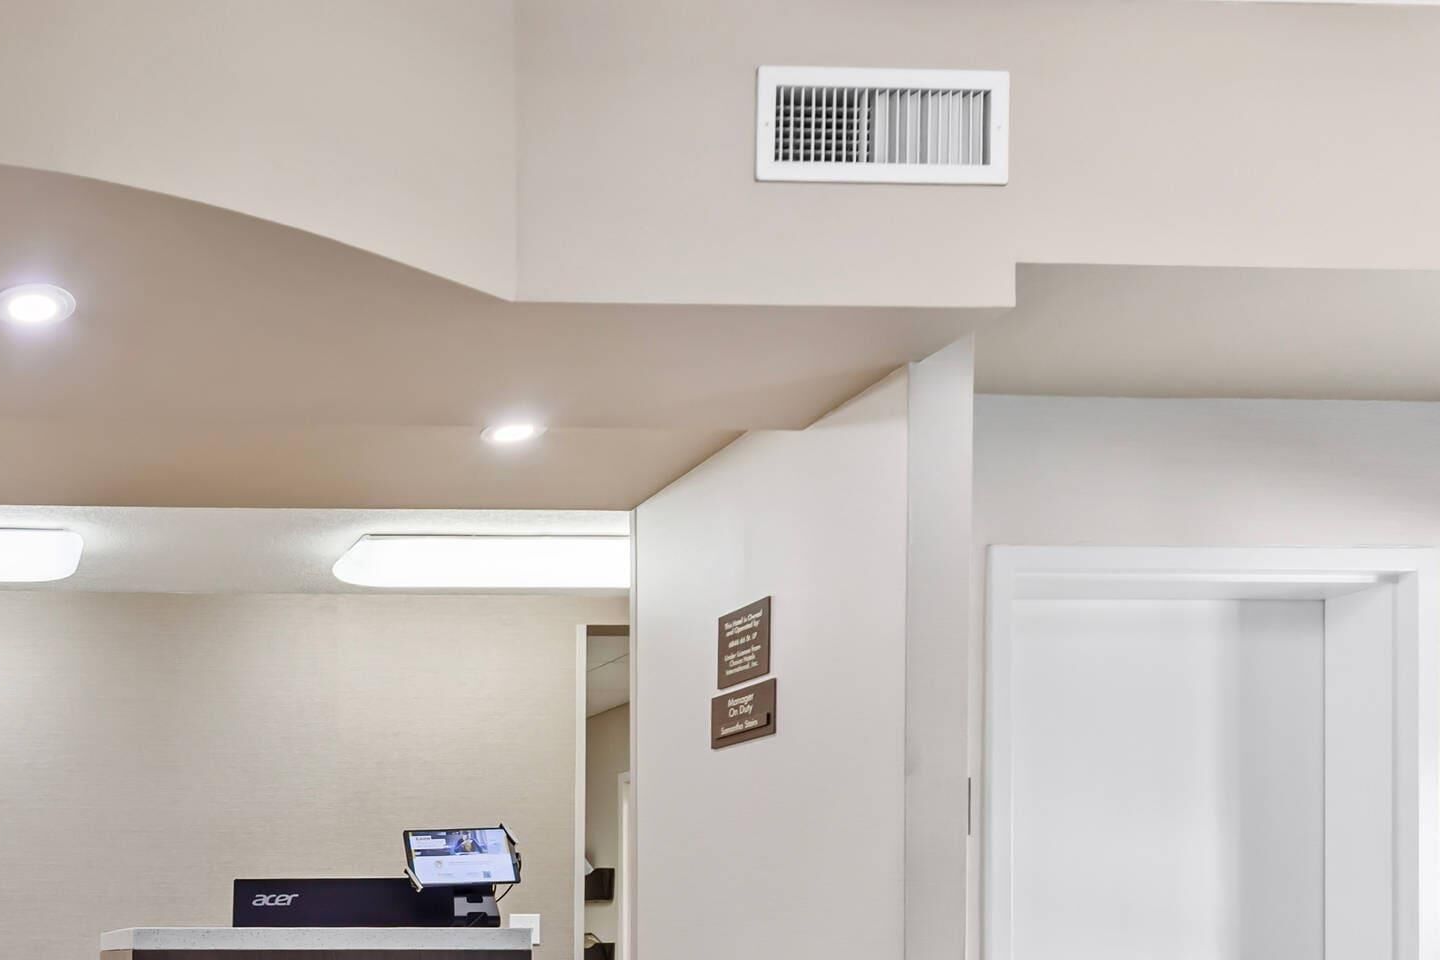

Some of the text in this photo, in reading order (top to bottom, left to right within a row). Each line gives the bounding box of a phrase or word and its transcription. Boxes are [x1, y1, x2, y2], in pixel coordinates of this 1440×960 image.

[727, 692, 754, 708] Manager
[729, 704, 753, 718] On Duty
[251, 894, 299, 906] acer
